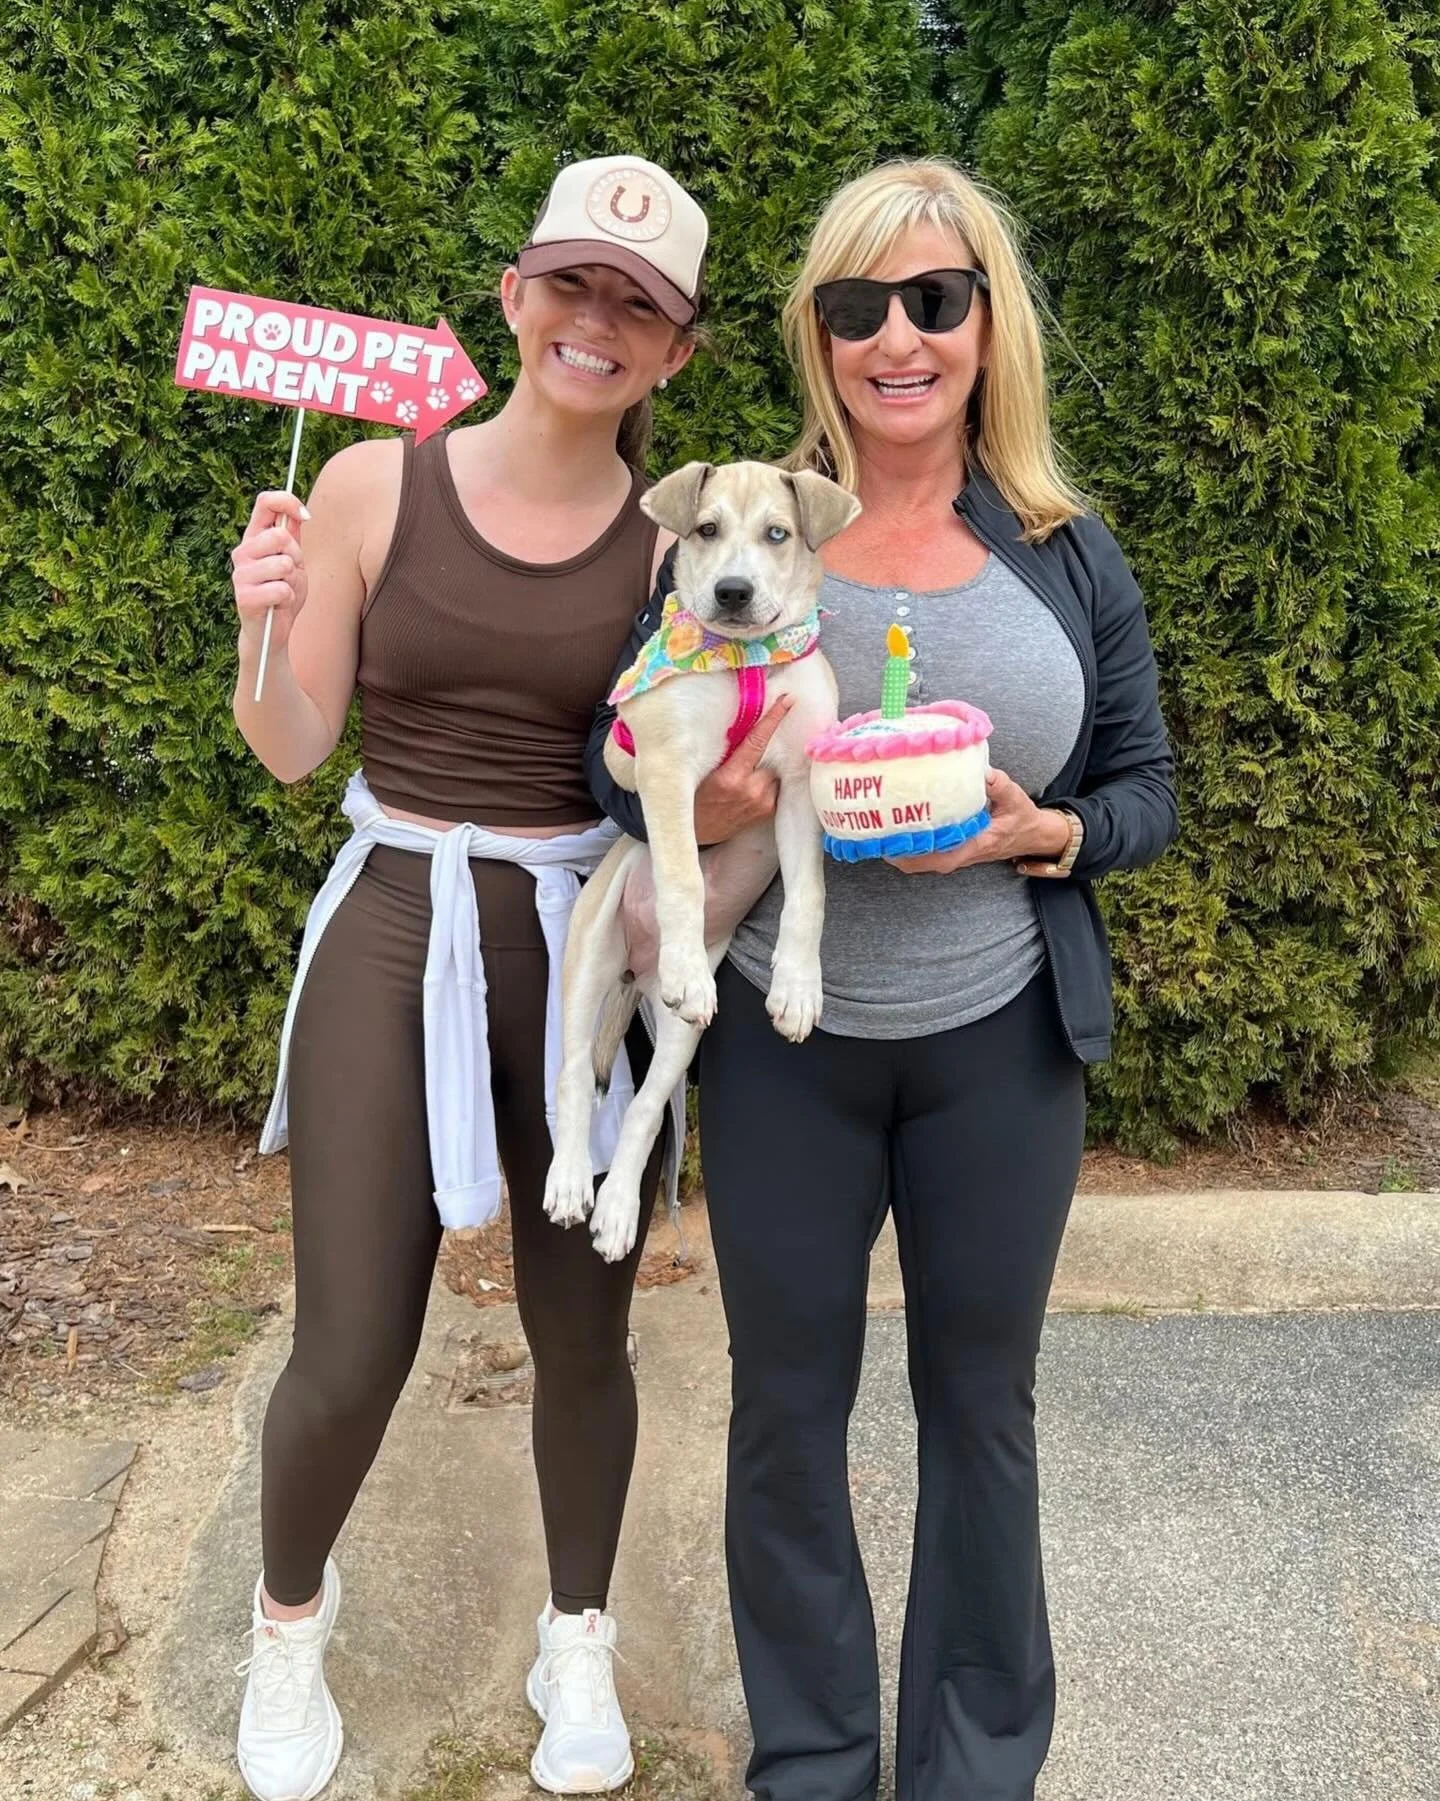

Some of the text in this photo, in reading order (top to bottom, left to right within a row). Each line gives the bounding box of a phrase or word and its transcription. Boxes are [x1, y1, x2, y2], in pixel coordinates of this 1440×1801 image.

[192, 299, 454, 384] PROUD PET
[183, 340, 369, 414] PARENT
[834, 775, 883, 800] HAPPY
[892, 801, 931, 825] DAY!
